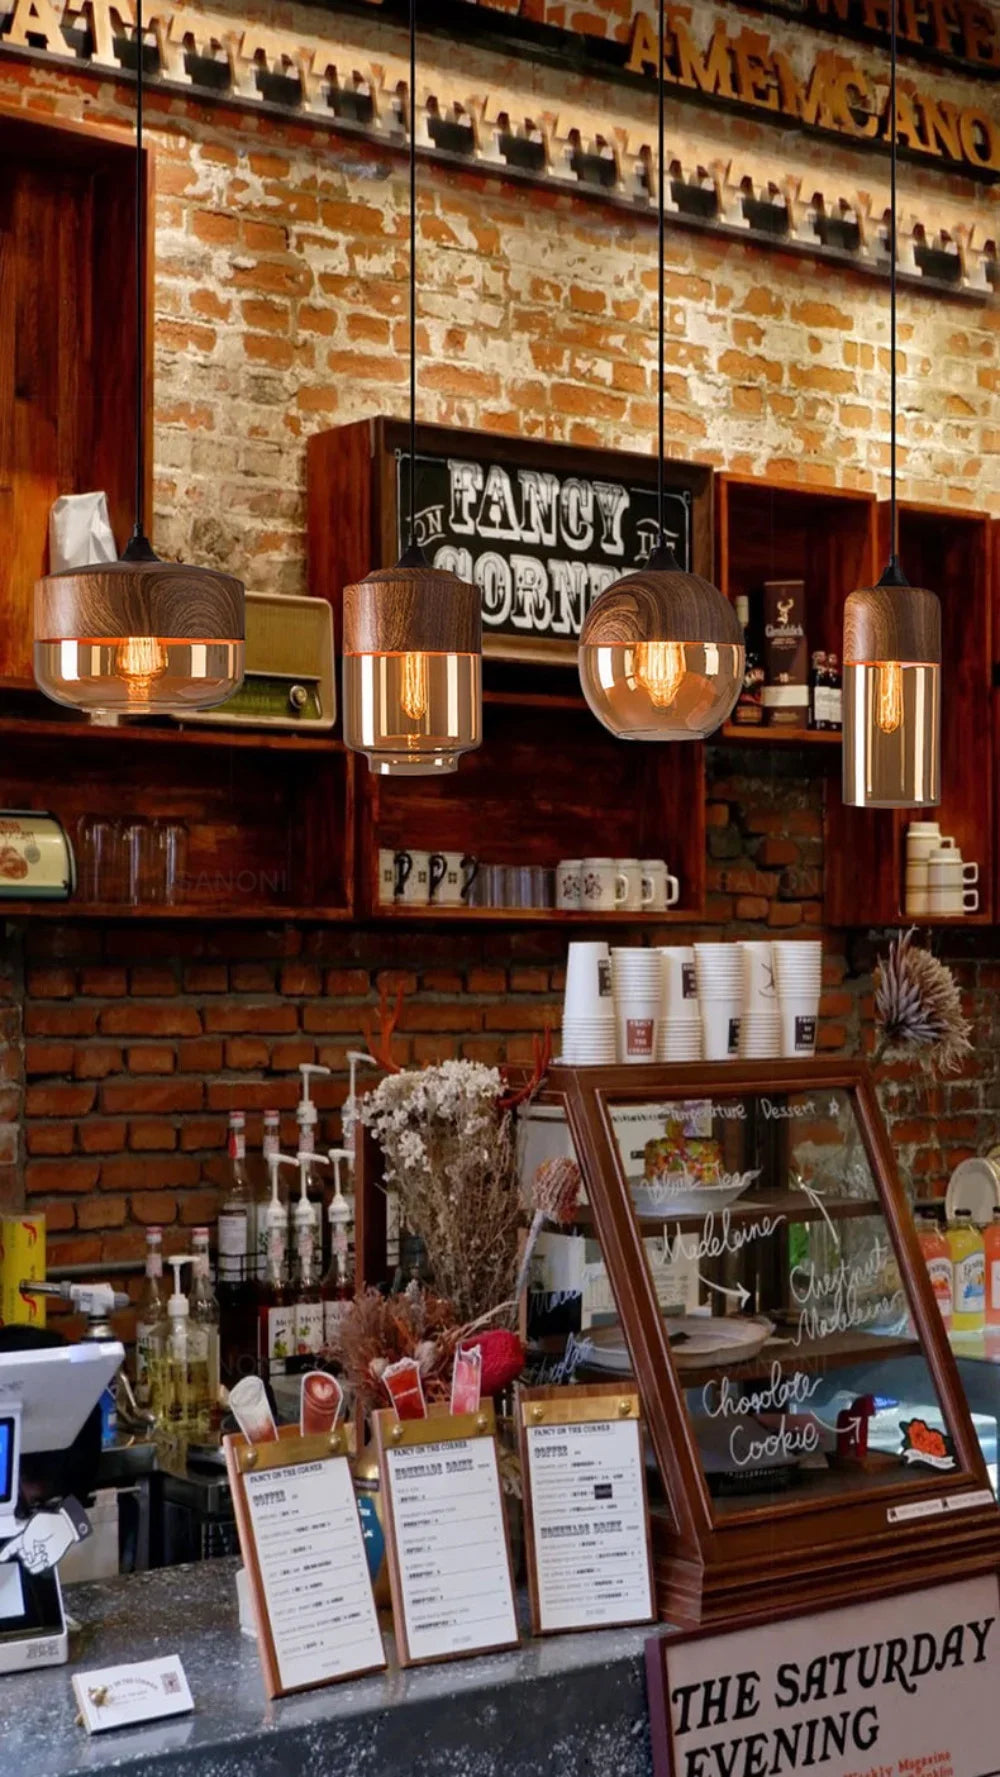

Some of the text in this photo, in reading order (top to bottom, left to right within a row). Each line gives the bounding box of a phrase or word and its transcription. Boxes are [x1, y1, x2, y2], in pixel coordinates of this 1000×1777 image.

[447, 458, 631, 556] FANCY
[760, 1097, 816, 1121] Dessert
[729, 1413, 820, 1467] Cookie
[671, 1617, 996, 1736] THE SATURDAY
[684, 1705, 880, 1777] EVENING
